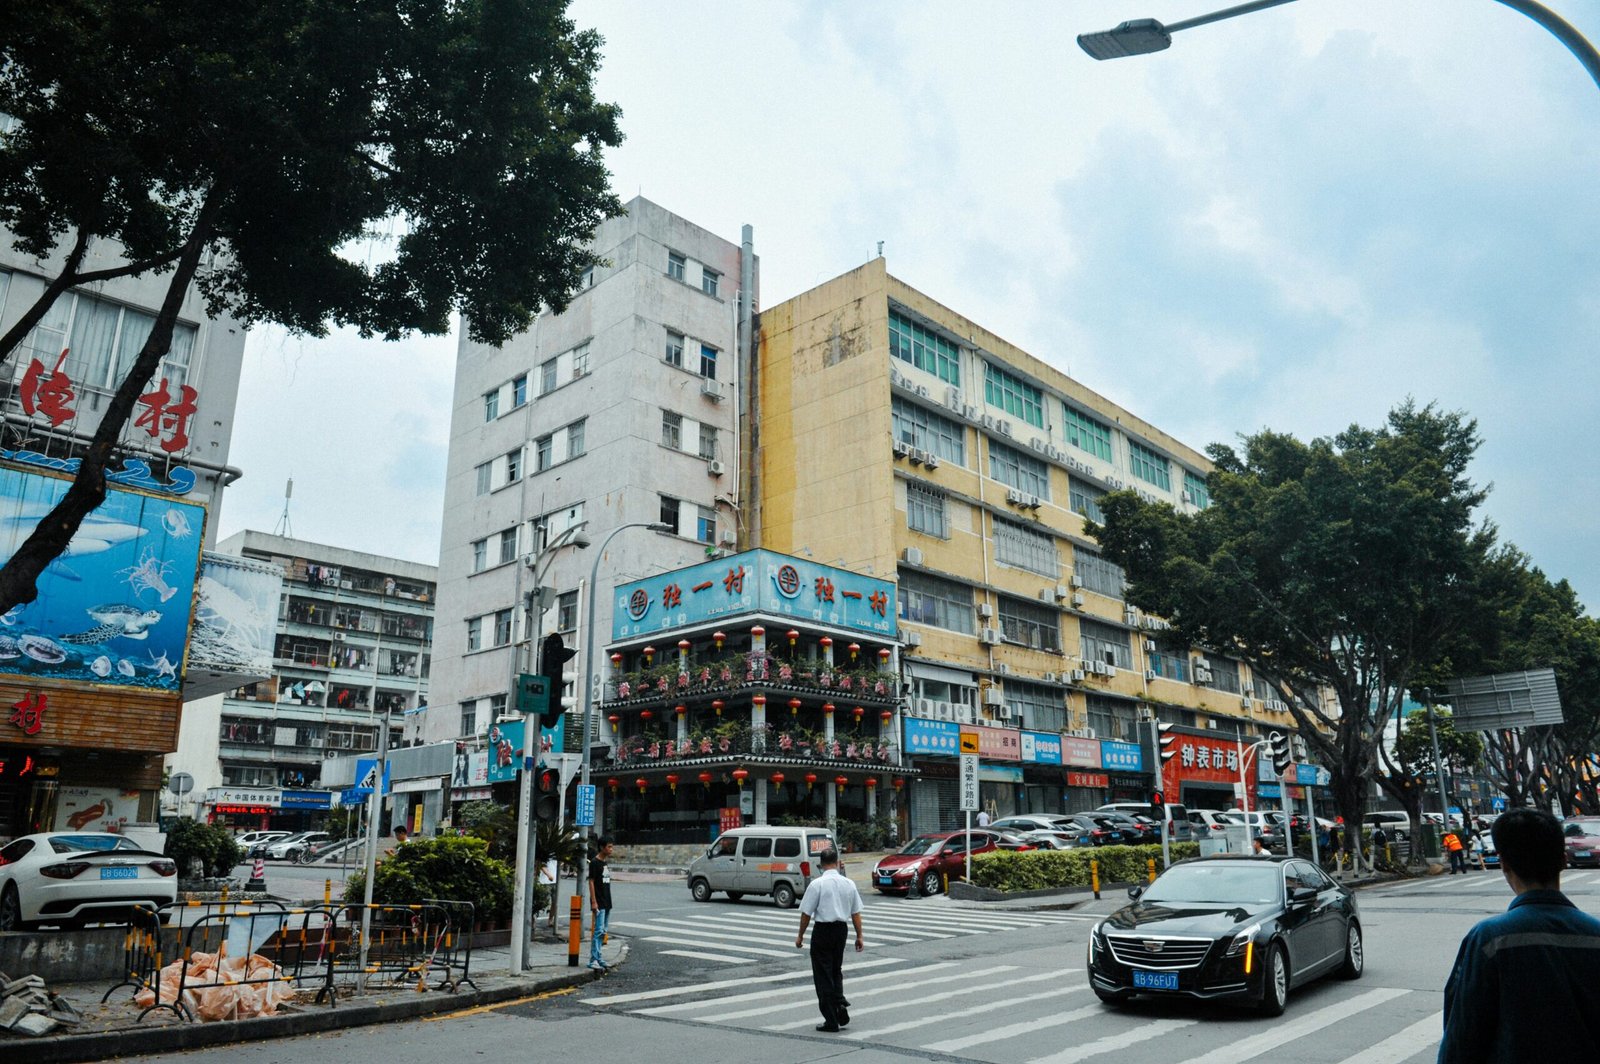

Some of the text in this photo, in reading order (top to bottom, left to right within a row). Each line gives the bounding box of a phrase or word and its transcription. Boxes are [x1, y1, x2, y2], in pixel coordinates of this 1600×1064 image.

[663, 565, 745, 609] 独一村
[814, 576, 888, 617] 独一村
[9, 691, 48, 734] 村
[1181, 743, 1238, 772] 钟表市场
[234, 793, 280, 802] 中国体育彩票
[965, 756, 974, 807] 交通繁忙路段
